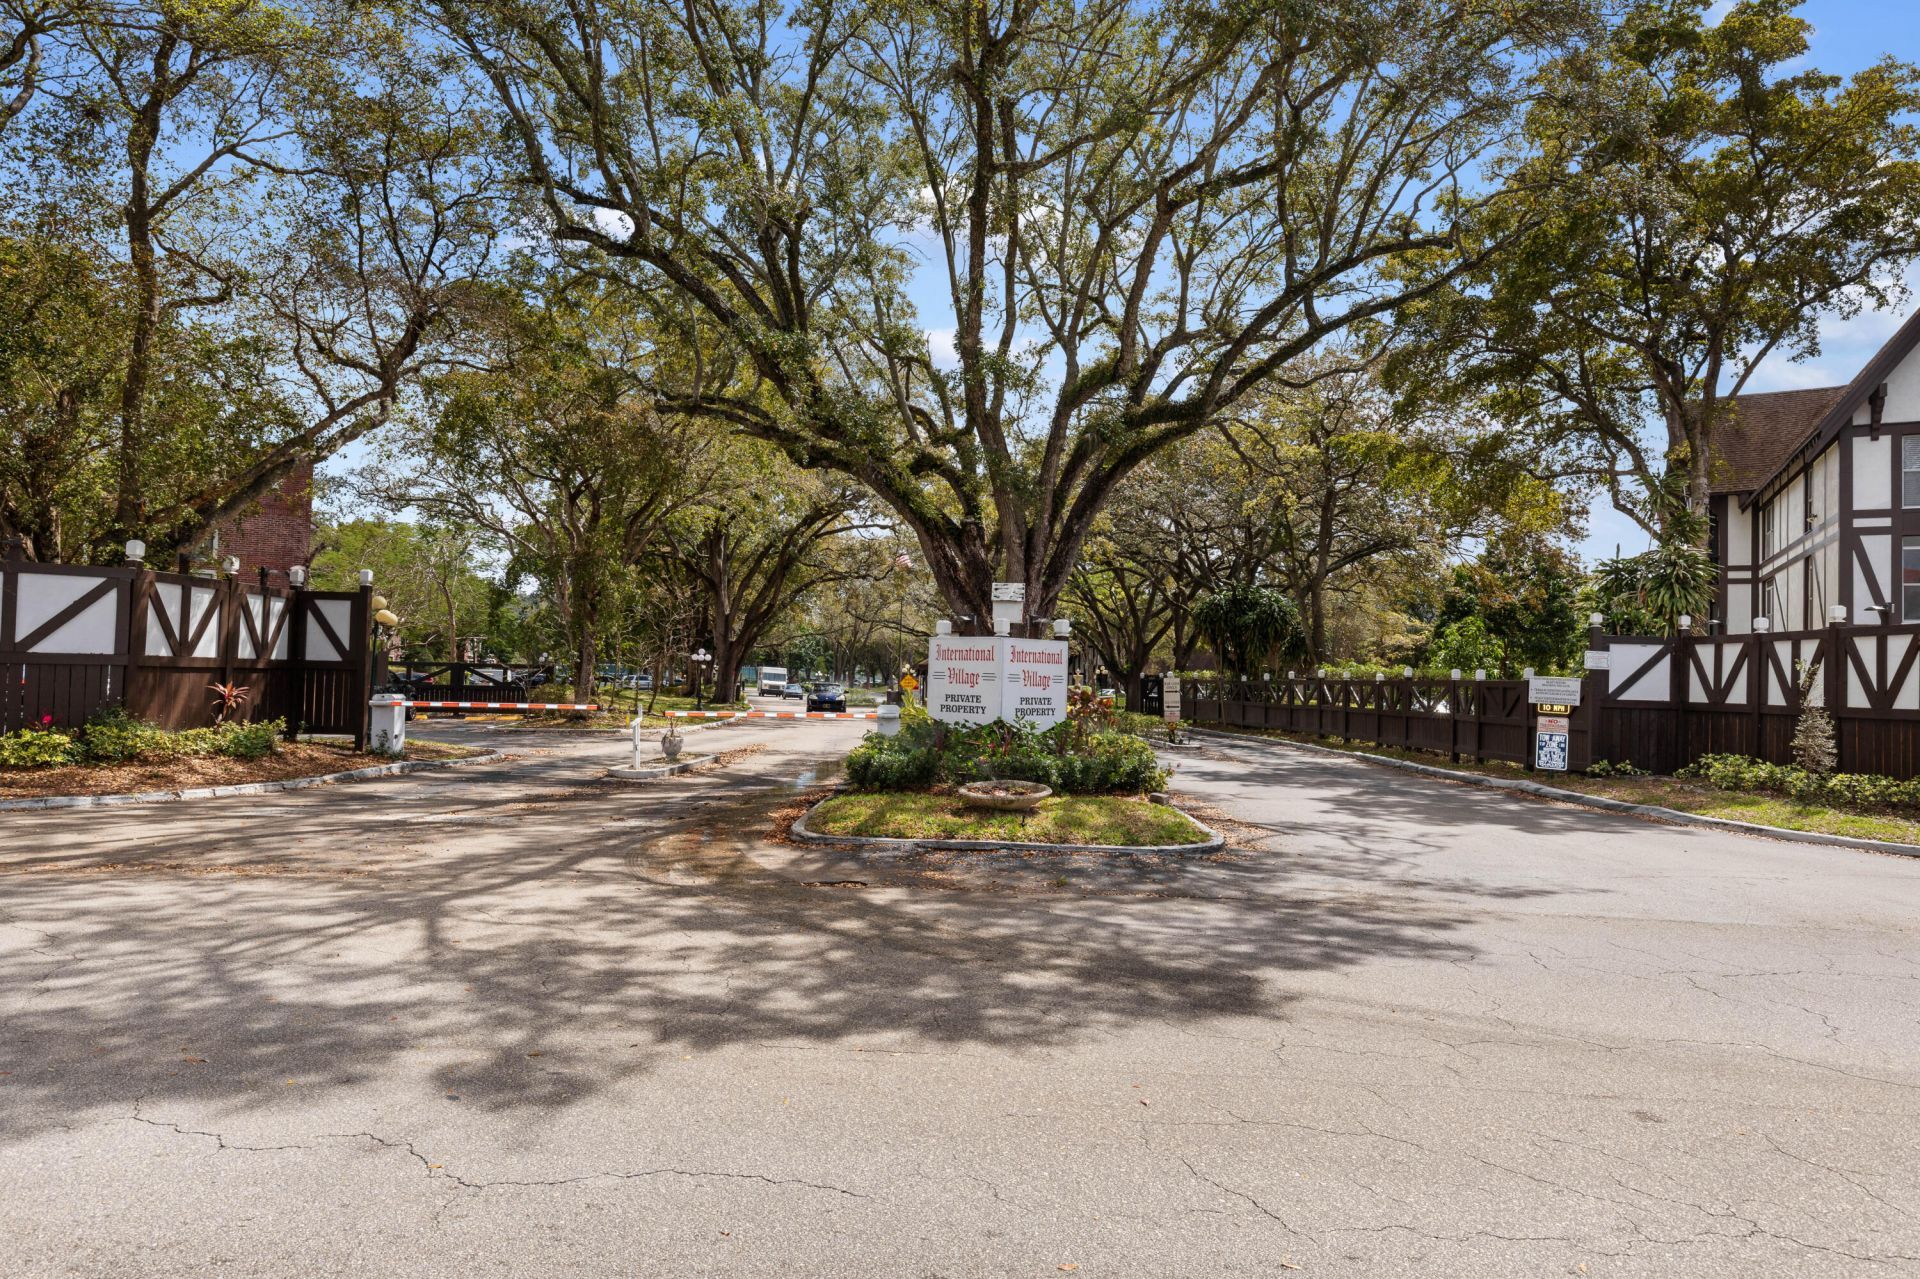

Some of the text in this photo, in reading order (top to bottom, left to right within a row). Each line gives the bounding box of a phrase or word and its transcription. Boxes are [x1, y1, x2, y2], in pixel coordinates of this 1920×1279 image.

[936, 644, 995, 662] International
[1010, 645, 1063, 665] International
[947, 667, 980, 688] Village
[1022, 669, 1051, 690] Village
[945, 694, 982, 704] PRIVATE
[1019, 697, 1052, 706] PRIVATE
[940, 704, 987, 715] PROPERTY
[1015, 708, 1056, 717] PROPERTY
[1553, 704, 1565, 712] MPH
